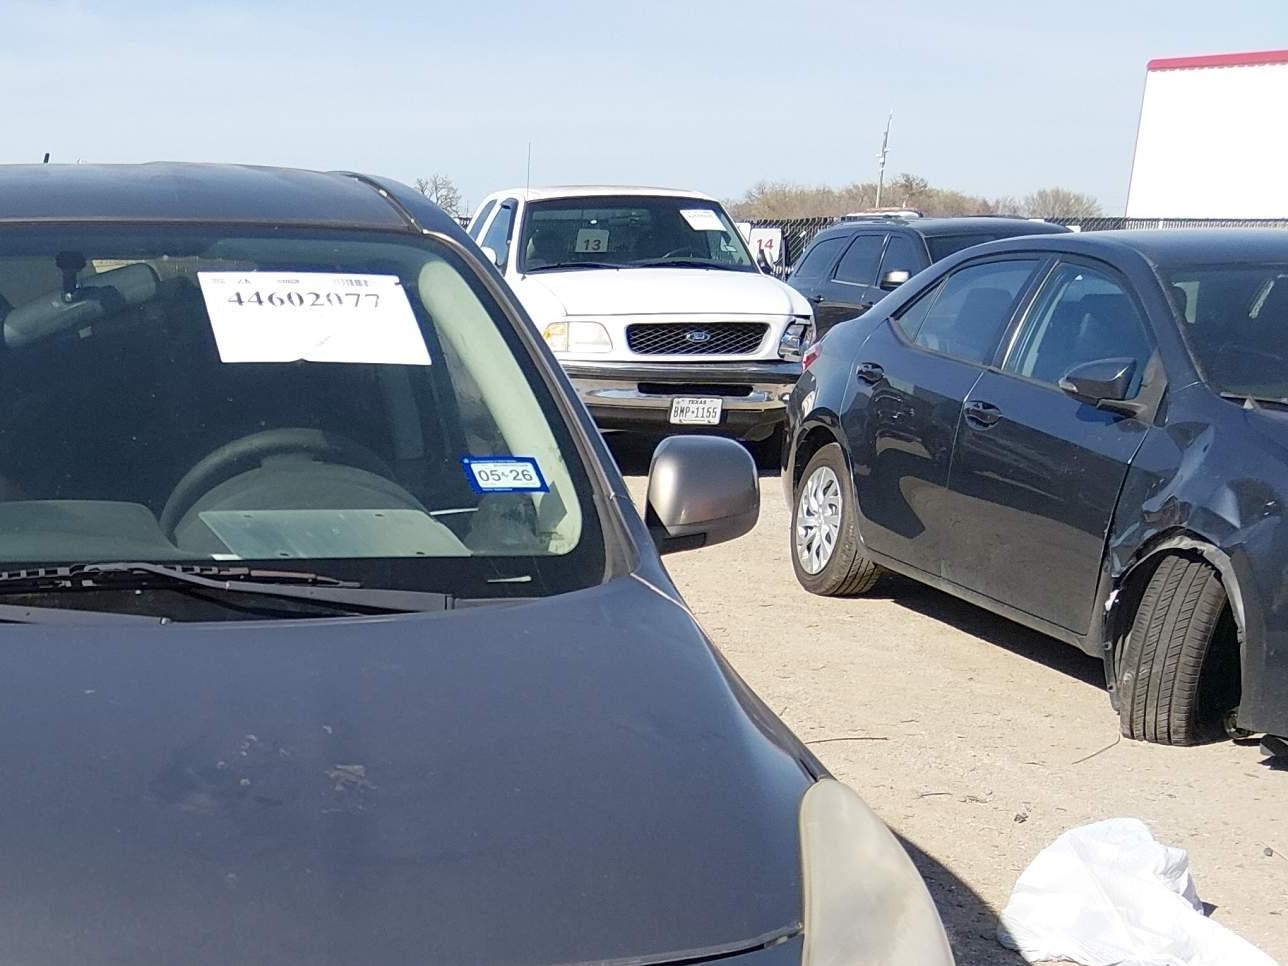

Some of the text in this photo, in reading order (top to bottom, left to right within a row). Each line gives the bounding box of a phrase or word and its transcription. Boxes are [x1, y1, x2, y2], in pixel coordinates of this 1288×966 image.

[583, 239, 602, 251] 13
[757, 238, 774, 250] 14
[227, 291, 380, 308] 44602077
